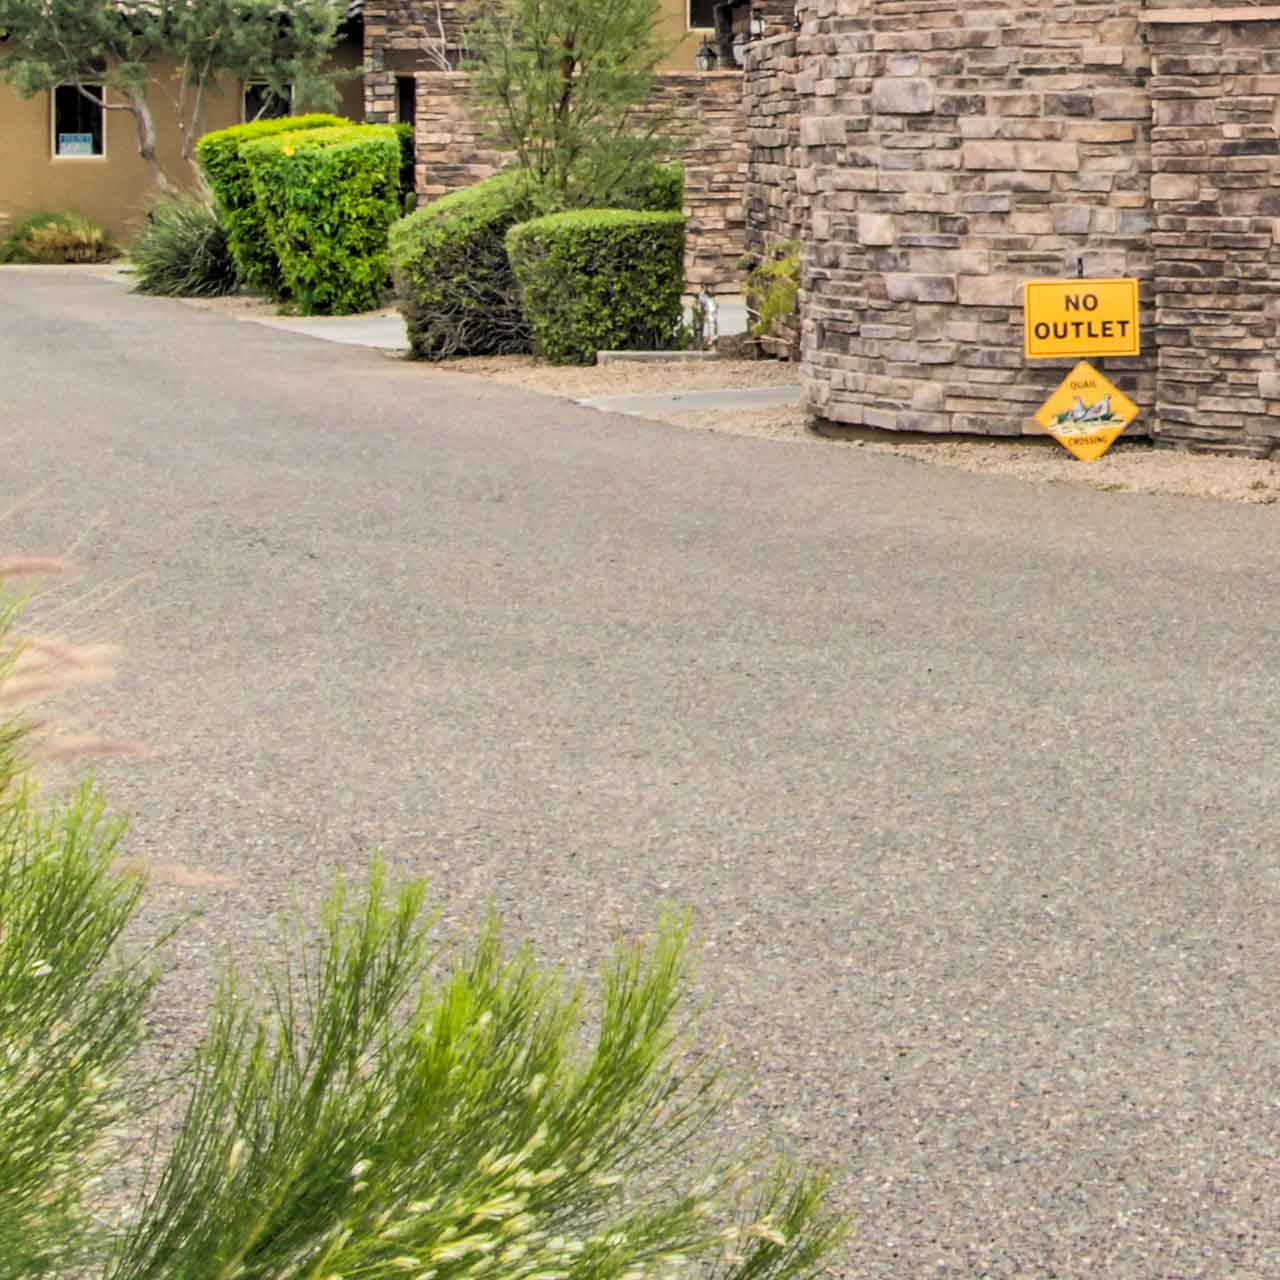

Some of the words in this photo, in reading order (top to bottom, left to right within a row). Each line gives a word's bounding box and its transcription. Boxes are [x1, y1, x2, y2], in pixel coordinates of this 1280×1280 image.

[1065, 294, 1098, 312] NO
[1034, 320, 1130, 340] OUTLET
[1070, 380, 1098, 390] QUAIL
[1067, 435, 1108, 447] CROSSING
